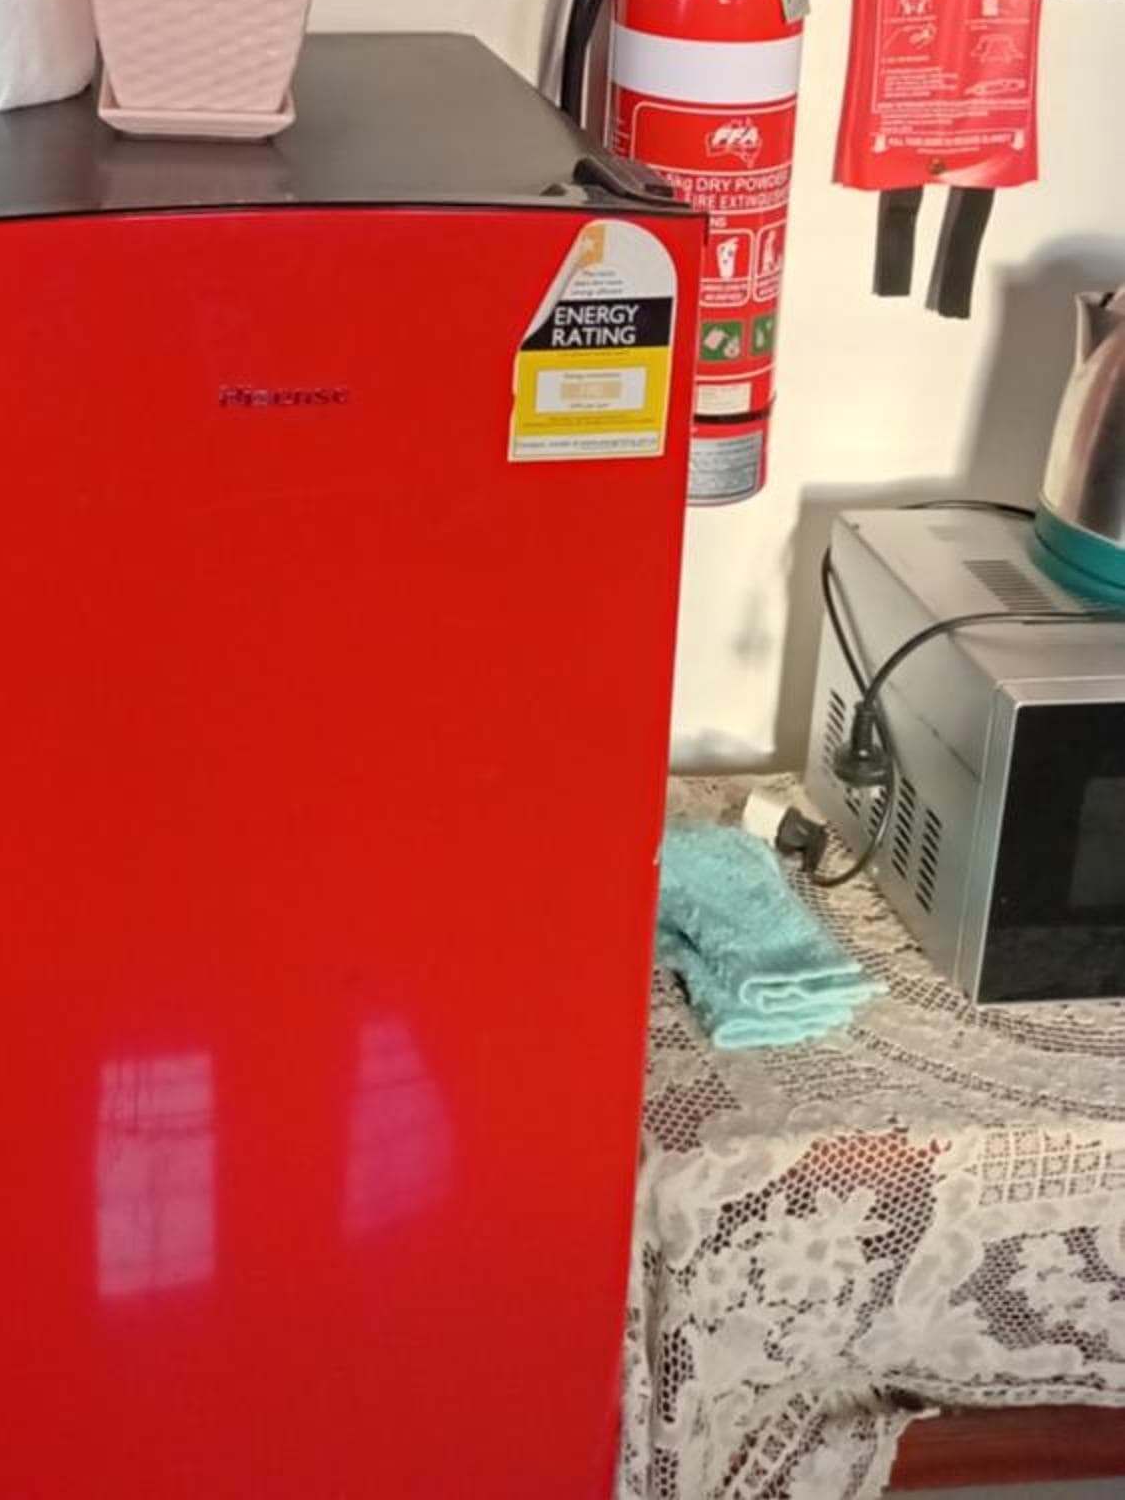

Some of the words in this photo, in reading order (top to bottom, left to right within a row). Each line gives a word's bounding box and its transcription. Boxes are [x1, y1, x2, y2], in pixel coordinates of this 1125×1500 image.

[695, 177, 732, 192] DRY
[554, 304, 639, 326] ENERGY
[551, 327, 637, 347] RATING
